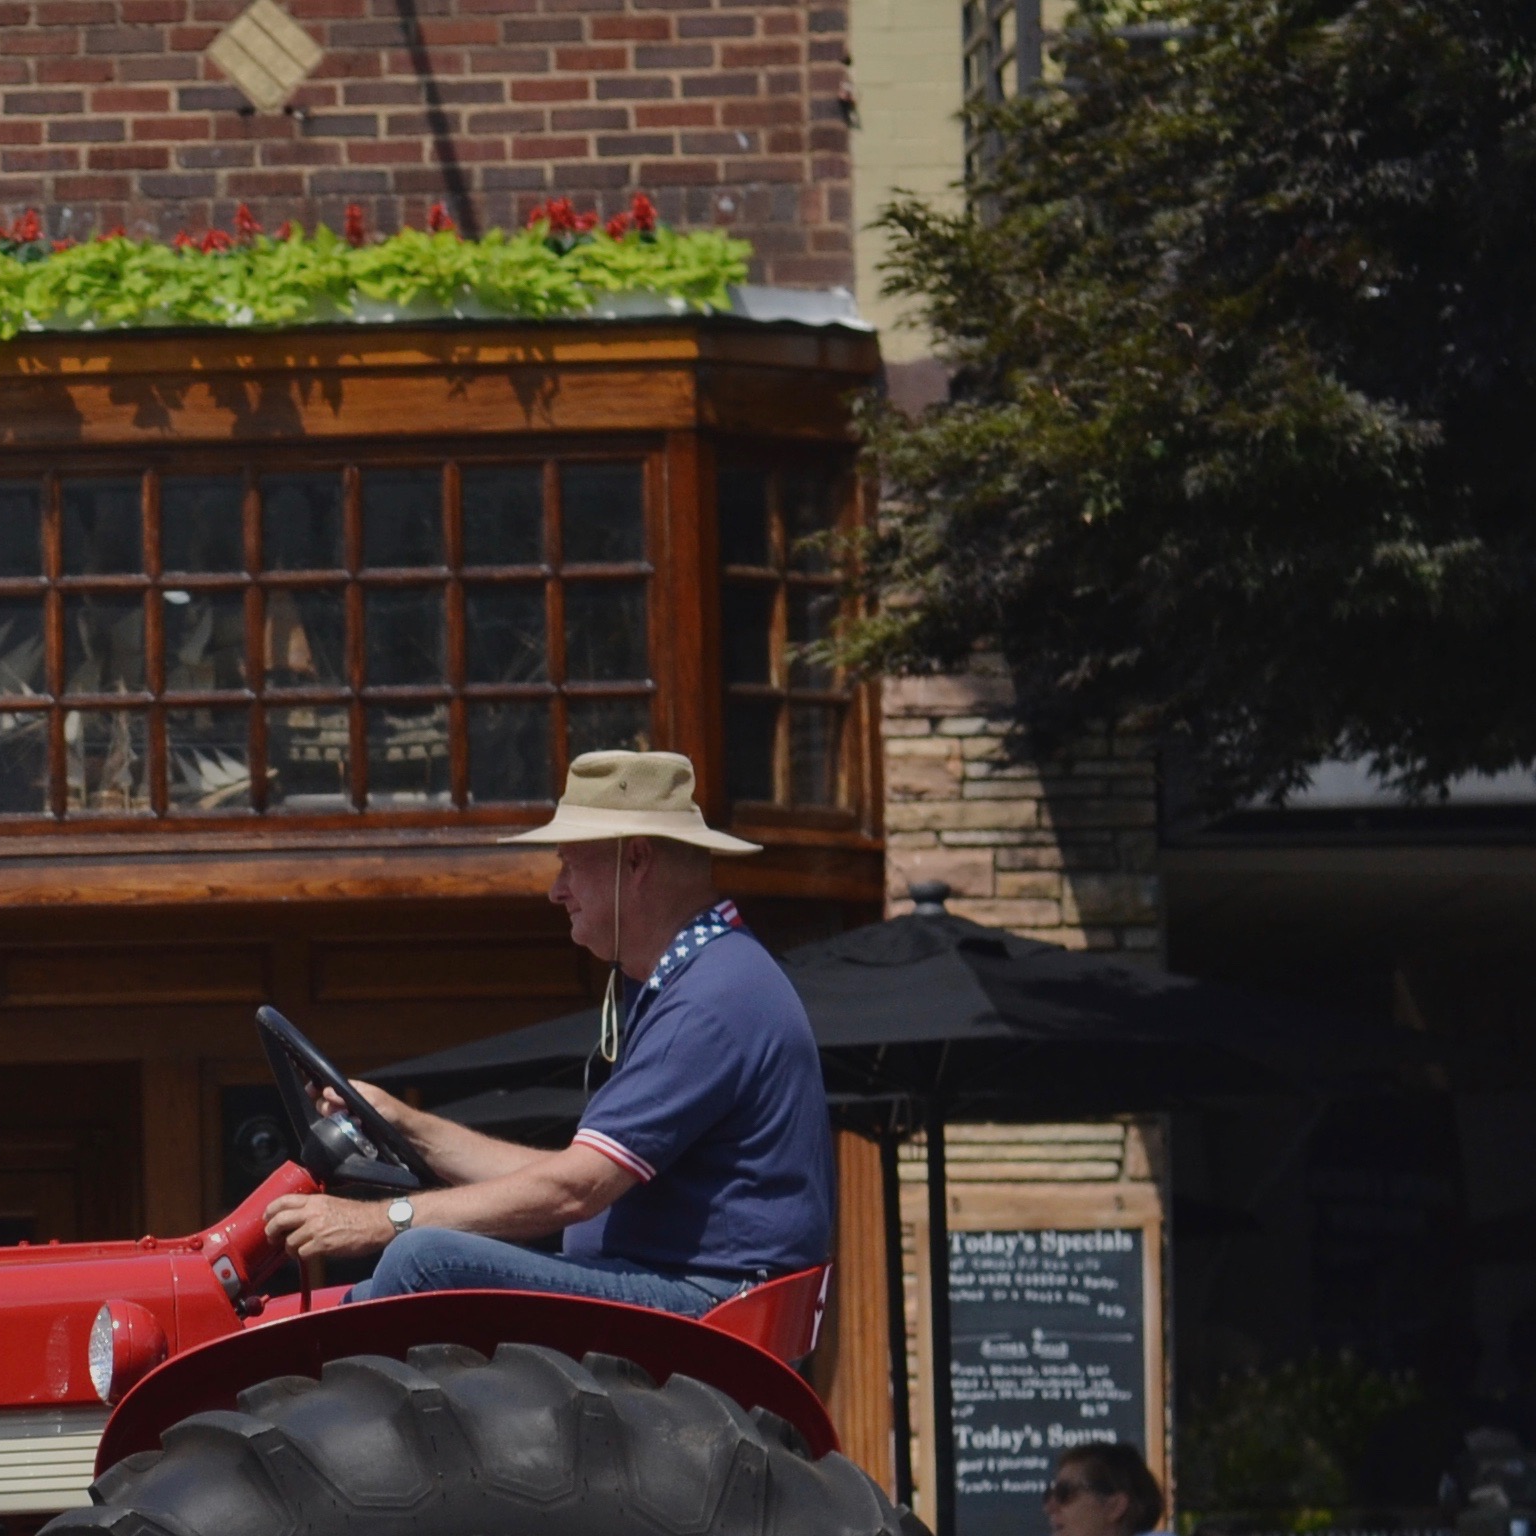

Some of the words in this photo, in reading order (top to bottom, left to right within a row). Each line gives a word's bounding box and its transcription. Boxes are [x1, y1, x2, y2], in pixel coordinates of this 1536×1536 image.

[948, 1231, 1036, 1259] Today's
[1040, 1230, 1134, 1258] Specials
[952, 1424, 1042, 1454] Today's
